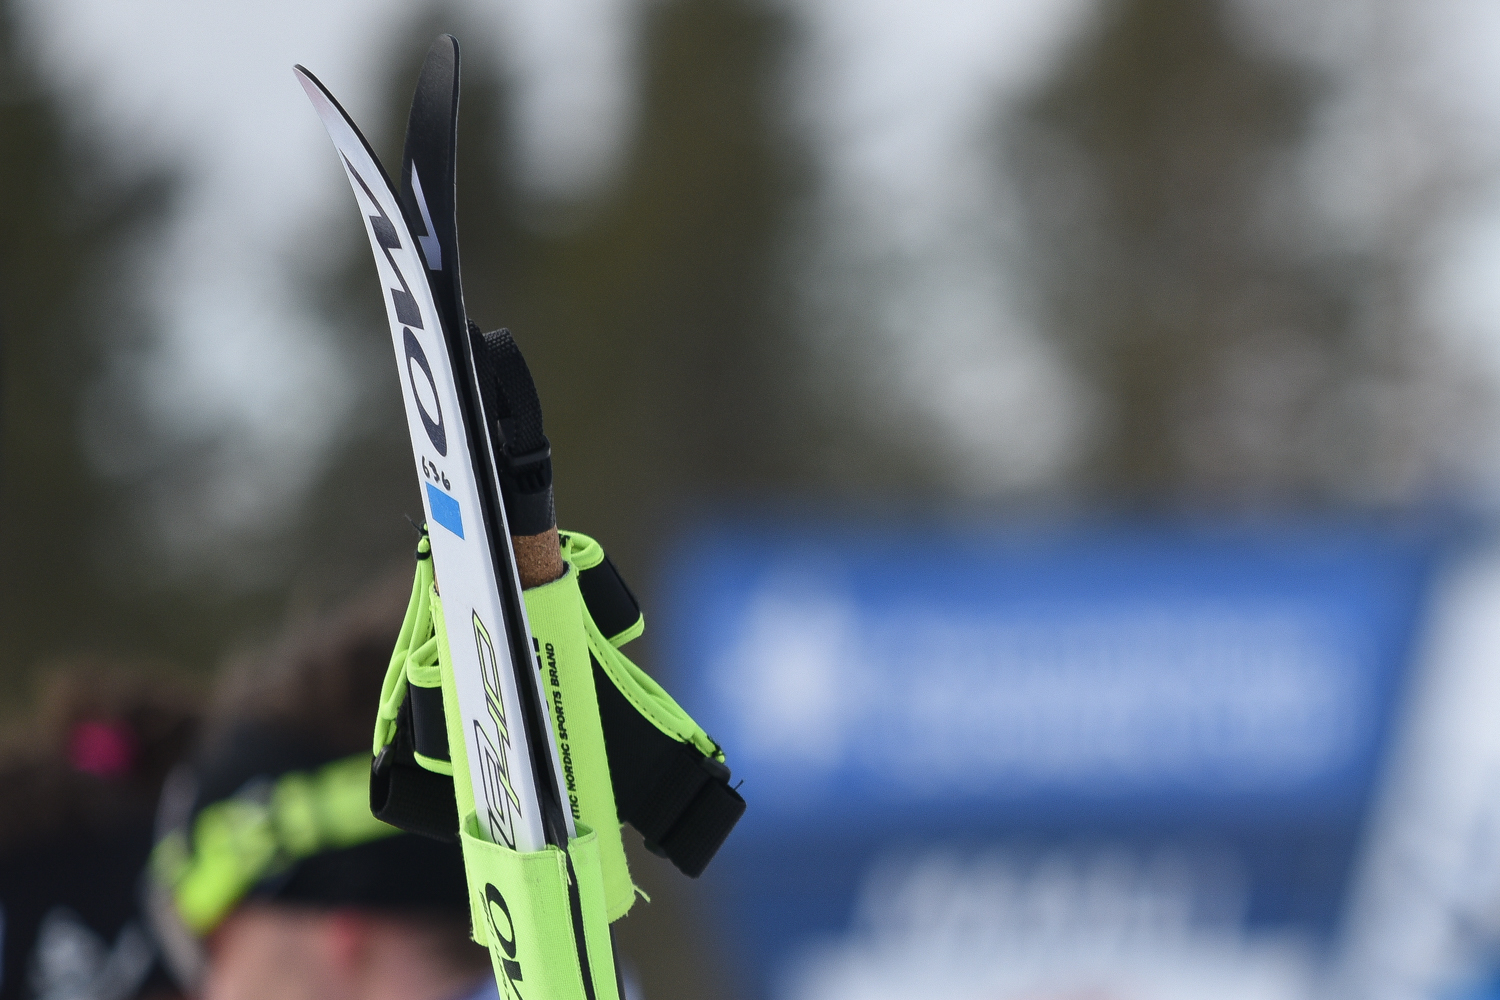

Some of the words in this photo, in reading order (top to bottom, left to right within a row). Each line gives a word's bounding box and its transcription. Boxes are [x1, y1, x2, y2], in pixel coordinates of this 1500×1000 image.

[545, 642, 560, 687] BRAND
[552, 690, 569, 740] SPORTS
[560, 743, 577, 792] NORDIC
